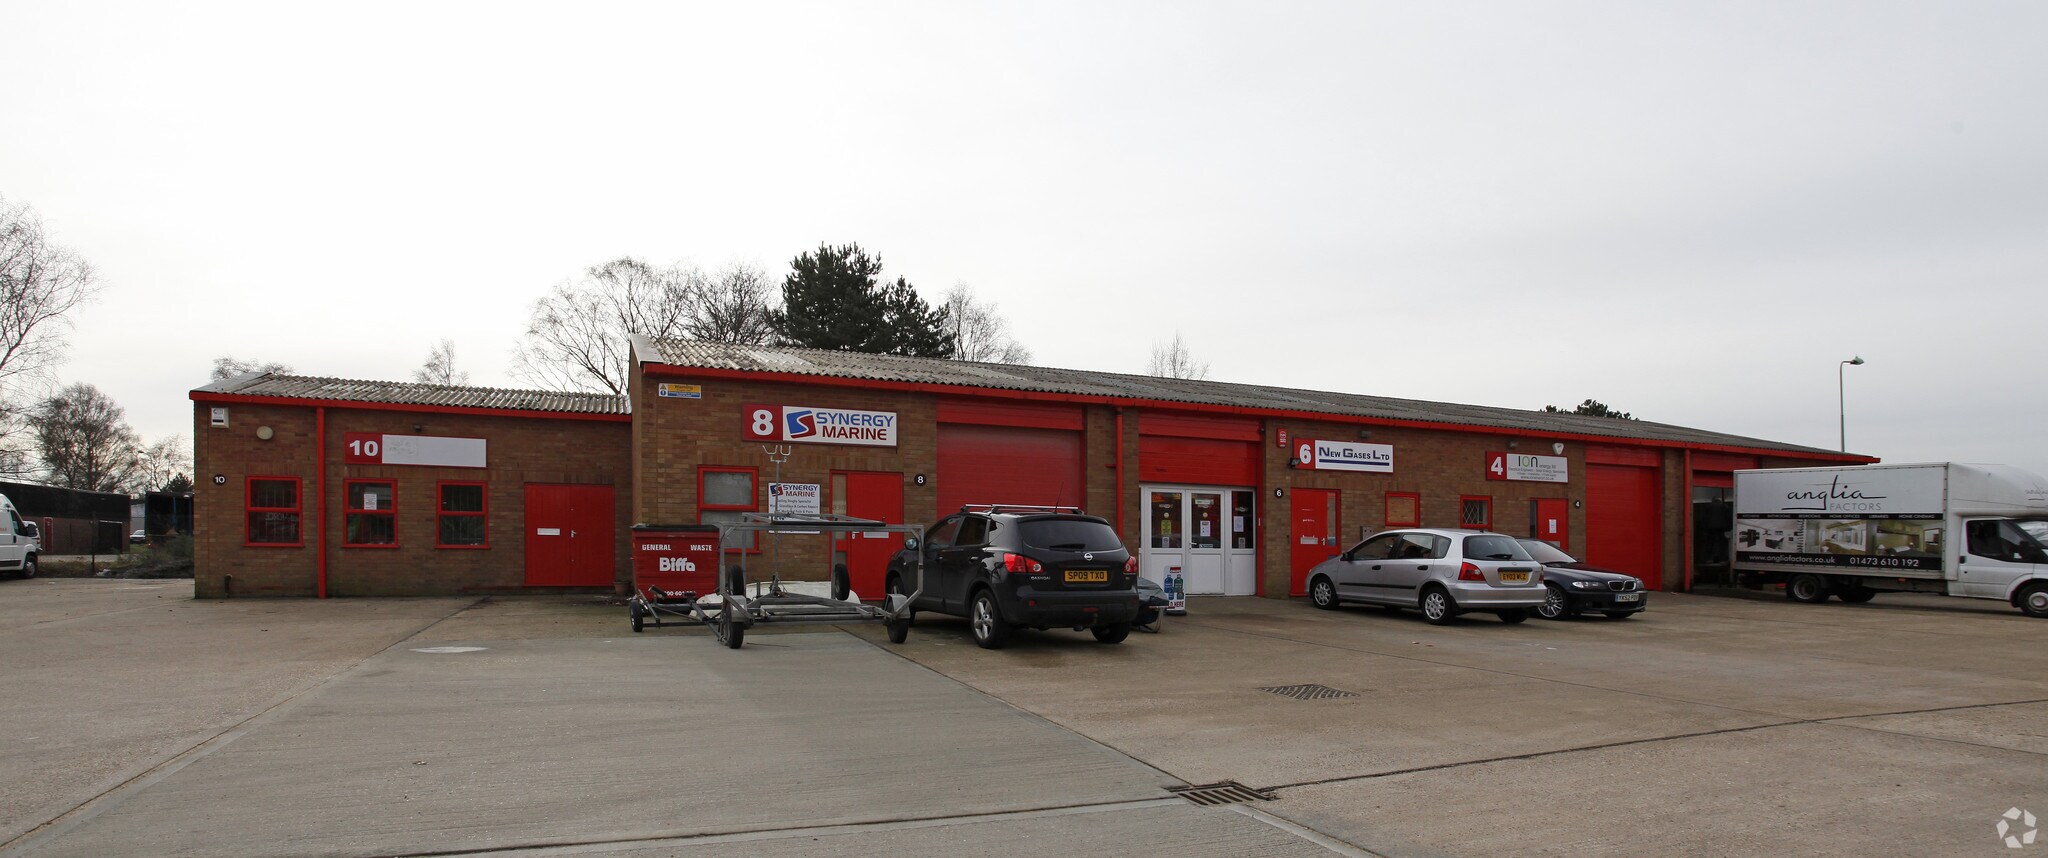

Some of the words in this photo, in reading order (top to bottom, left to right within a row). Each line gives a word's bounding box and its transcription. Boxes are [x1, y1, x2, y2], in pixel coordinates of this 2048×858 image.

[752, 409, 774, 436] 8
[816, 412, 894, 427] SYNERGY
[822, 425, 887, 441] MARINE
[349, 440, 379, 457] 10
[1300, 444, 1312, 464] 6
[1319, 446, 1341, 458] NEW
[1342, 448, 1371, 460] GASES
[1373, 450, 1390, 460] LTD
[1491, 457, 1503, 475] 4
[214, 476, 226, 484] 10
[917, 475, 924, 484] 8
[1781, 475, 1887, 510] anglia
[1829, 502, 1882, 511] FACTORS
[690, 544, 712, 552] WASTE
[659, 557, 696, 572] Biffa
[1749, 554, 1836, 564] www.angliafactors.co.uk
[1849, 557, 1878, 566] 01473
[1880, 558, 1899, 566] 610
[1902, 558, 1919, 567] 192
[1068, 571, 1088, 580] SP09
